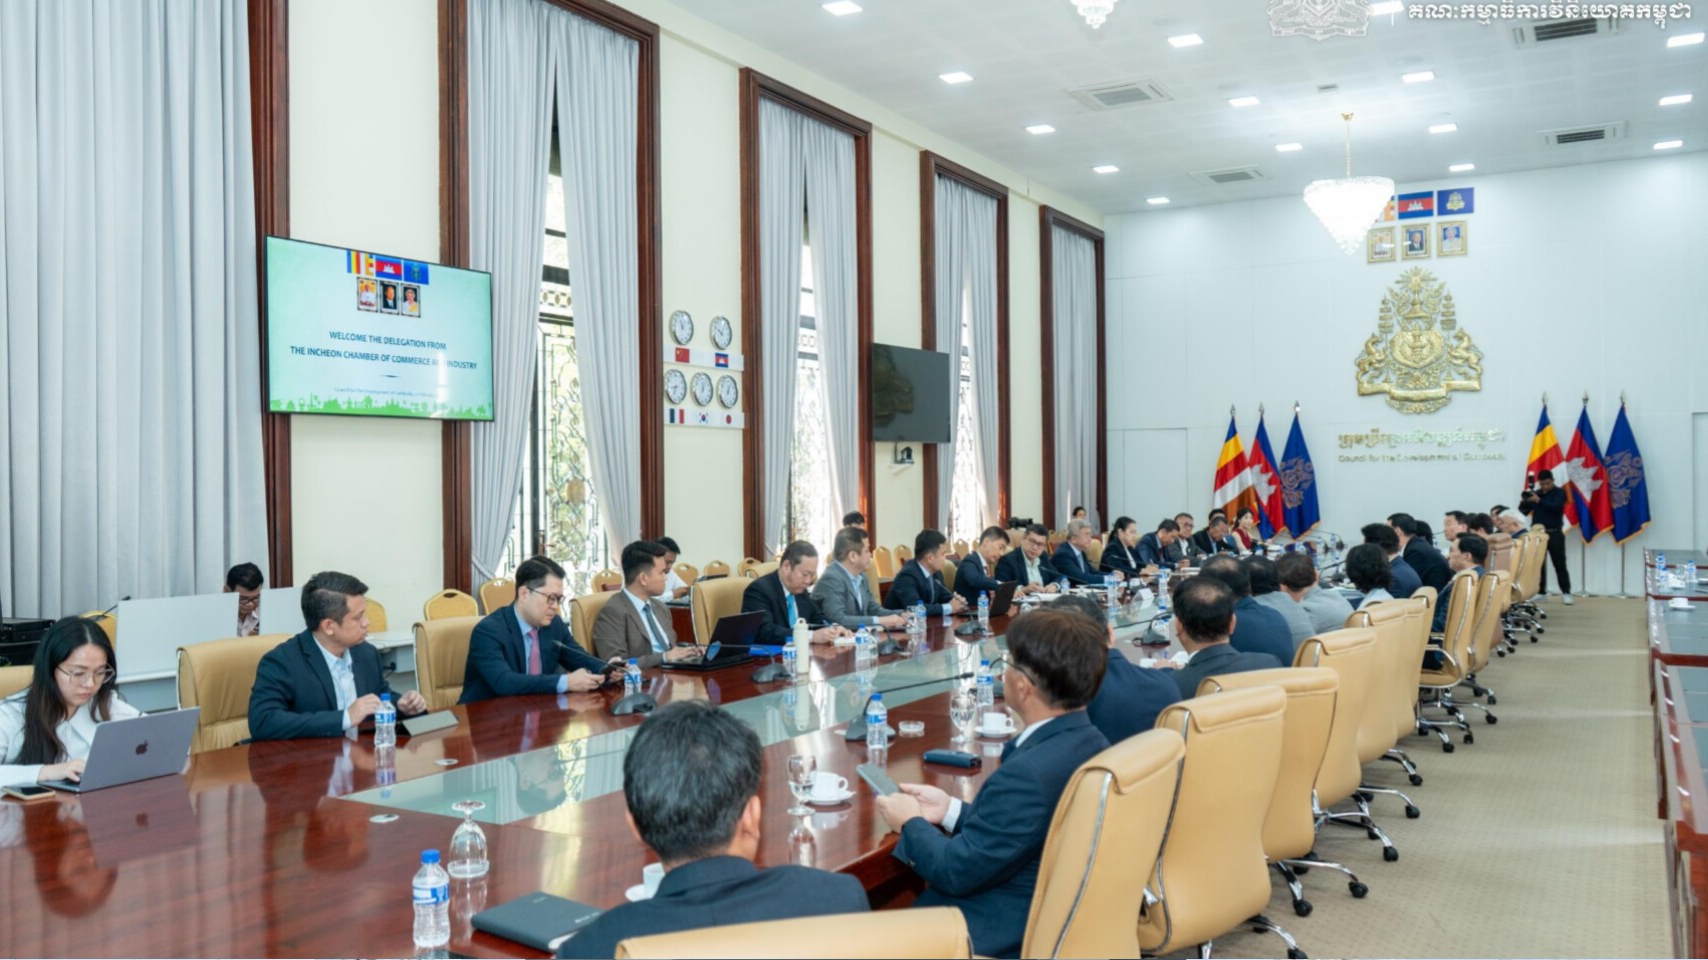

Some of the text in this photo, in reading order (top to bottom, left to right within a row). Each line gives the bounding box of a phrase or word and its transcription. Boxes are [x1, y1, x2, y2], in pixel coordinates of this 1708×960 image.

[329, 331, 447, 350] WELCOME THE DELEGATION FROM
[290, 345, 478, 370] THE INCHEON CHAMBER OF COMMERCE AN INDUSTRY
